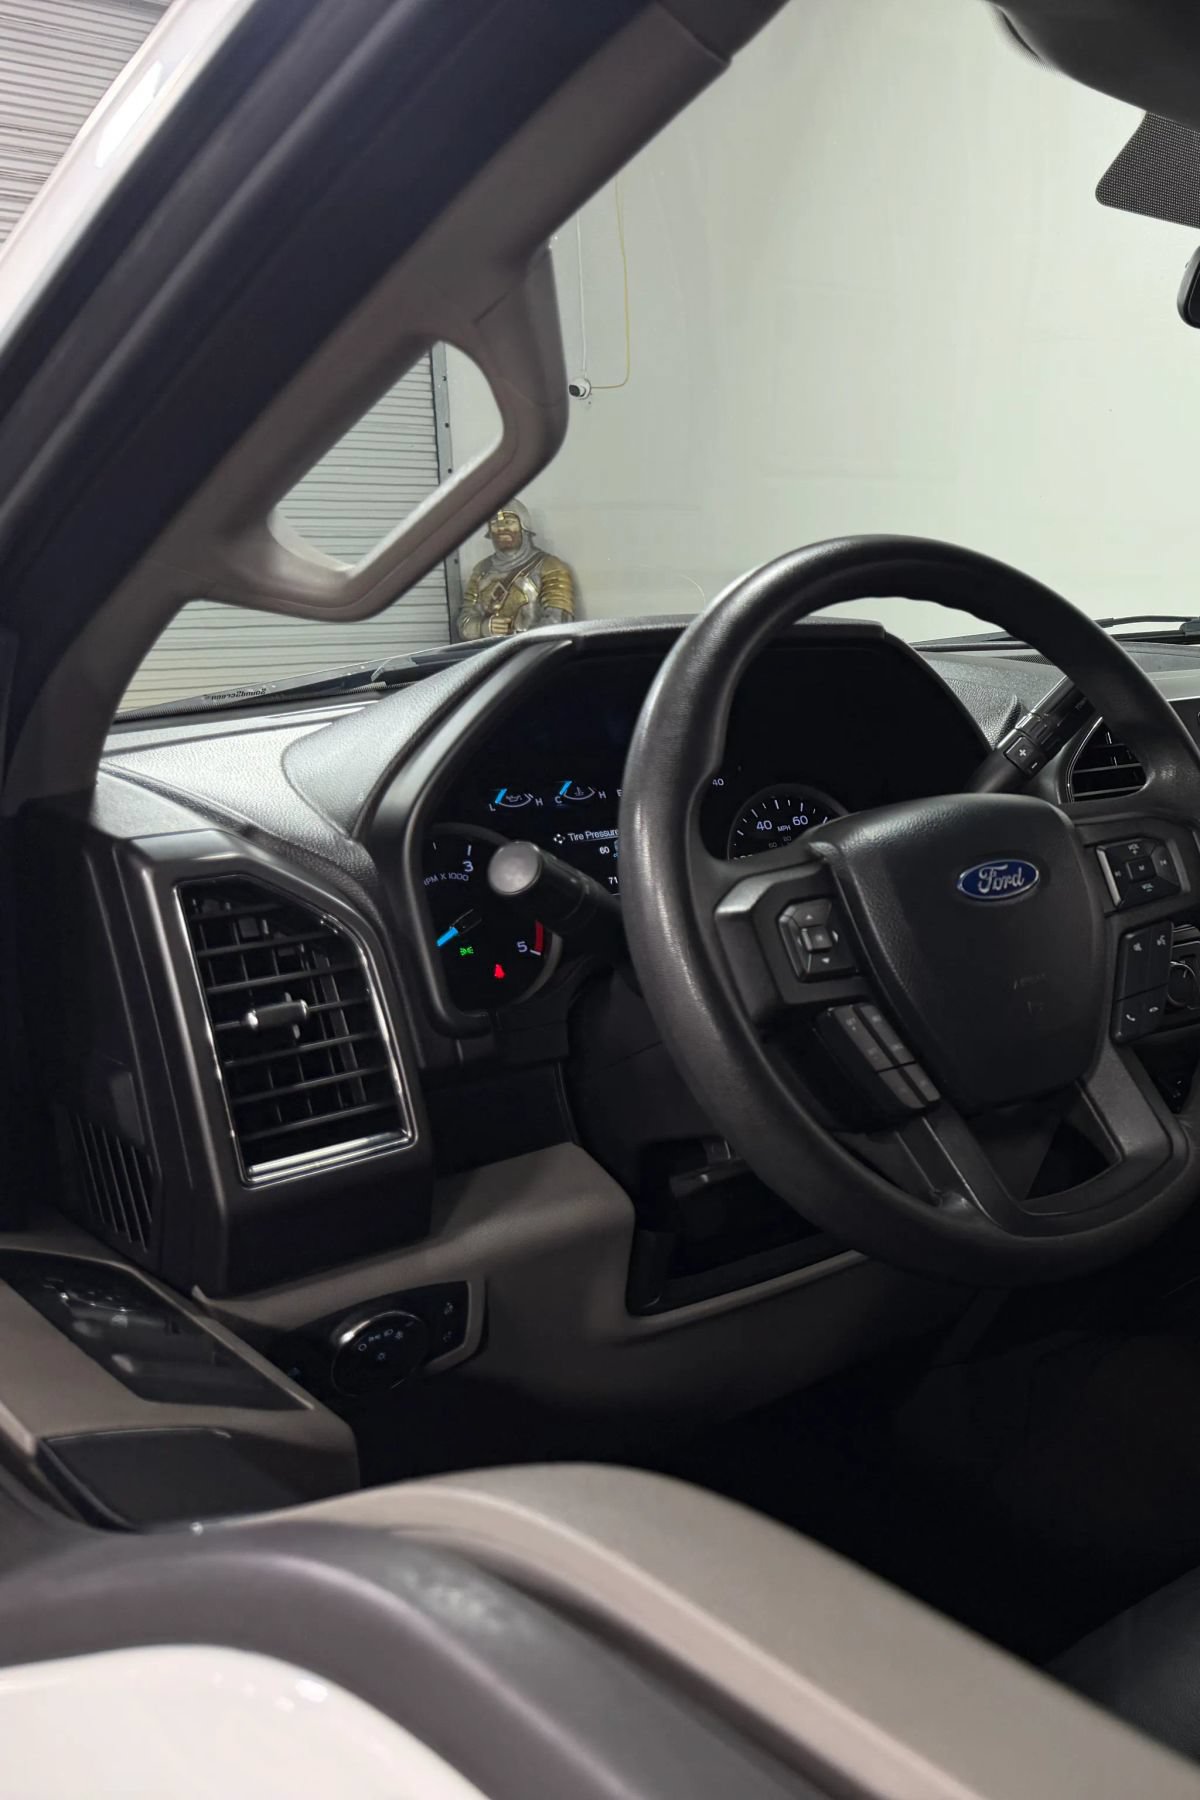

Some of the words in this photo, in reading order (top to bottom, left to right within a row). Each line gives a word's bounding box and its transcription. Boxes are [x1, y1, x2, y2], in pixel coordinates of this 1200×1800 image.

[712, 778, 724, 787] 40
[755, 819, 773, 831] 40
[791, 815, 809, 827] 60
[567, 832, 585, 842] Tire
[462, 861, 474, 872] 3
[978, 864, 1024, 894] Ford
[516, 941, 528, 953] 5
